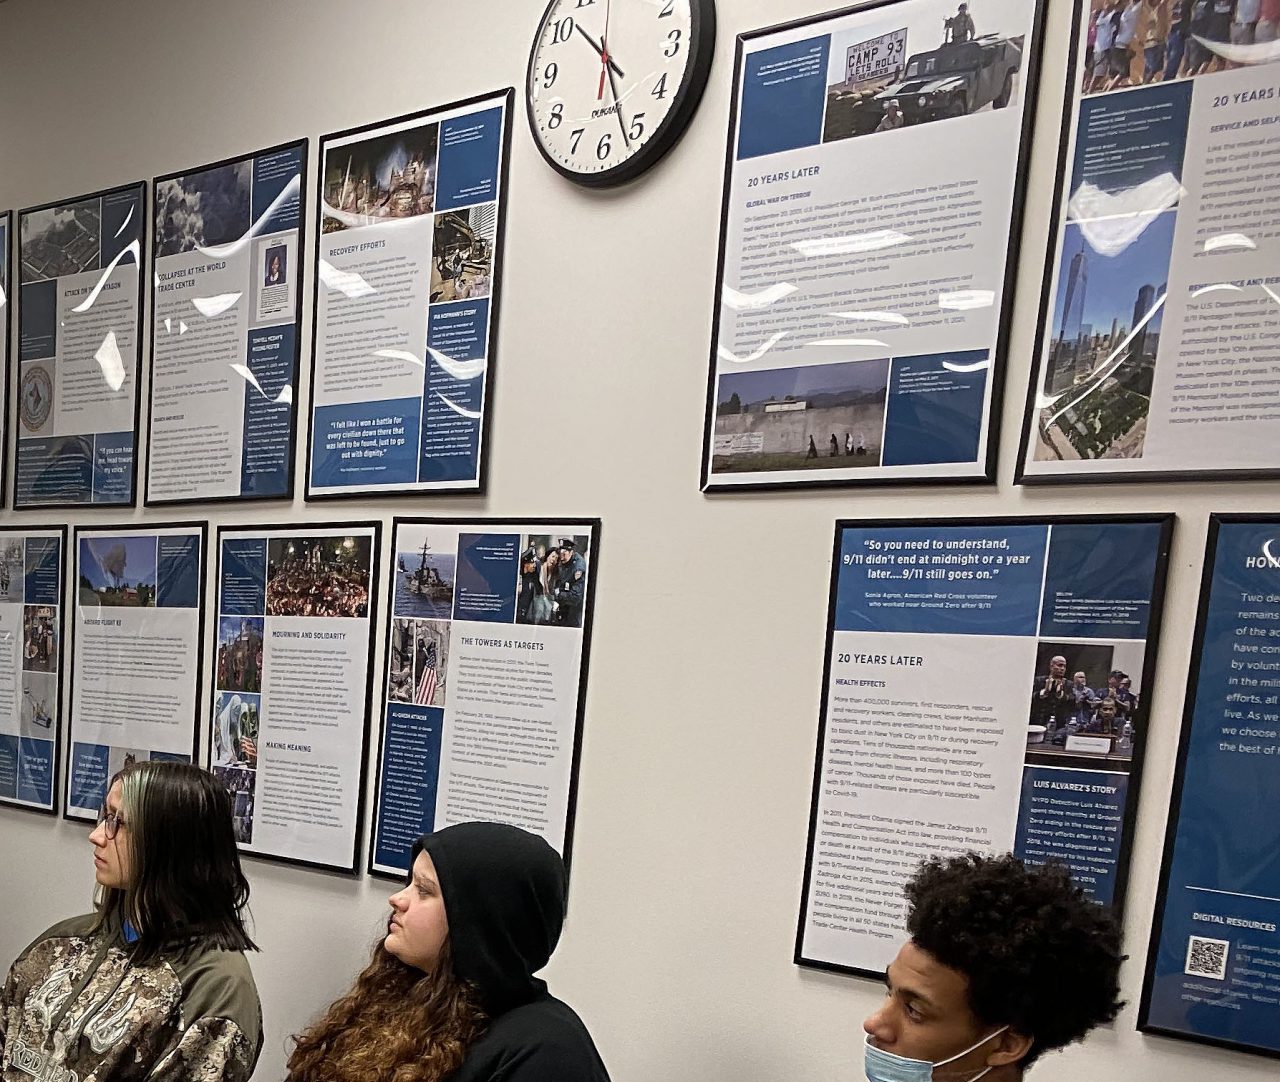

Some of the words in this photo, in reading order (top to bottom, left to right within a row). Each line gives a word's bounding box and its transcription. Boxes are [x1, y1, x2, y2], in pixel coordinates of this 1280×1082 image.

[658, 0, 674, 18] 2
[550, 16, 574, 45] 10
[664, 29, 681, 57] 3
[849, 47, 878, 68] CAMP
[888, 39, 903, 56] 93
[851, 63, 871, 76] LETS
[876, 56, 898, 69] ROLL
[544, 62, 558, 89] 9
[651, 72, 667, 100] 4
[1212, 96, 1228, 108] 20
[1234, 88, 1274, 104] YEARS
[548, 103, 564, 129] 8
[628, 112, 646, 140] 5
[570, 128, 585, 154] 7
[597, 133, 611, 160] 6
[748, 178, 758, 188] 20
[760, 172, 789, 184] YEARS
[792, 166, 820, 179] LATER
[330, 245, 358, 256] RECOVERY
[360, 240, 386, 251] EFFORTS
[206, 262, 226, 271] WORLD
[175, 280, 195, 290] CENTER
[393, 416, 402, 424] for
[397, 438, 405, 446] go
[884, 541, 902, 551] you
[905, 540, 929, 549] need
[932, 540, 943, 549] to
[946, 538, 1010, 550] understand,
[843, 554, 864, 565] 9/11
[866, 554, 895, 564] didn't
[897, 554, 916, 564] end
[918, 555, 930, 564] at
[932, 554, 980, 566] midnight
[982, 556, 994, 564] or
[996, 556, 1004, 564] a
[1006, 556, 1030, 566] year
[926, 569, 946, 578] still
[948, 571, 974, 580] goes
[1242, 593, 1263, 602] Two
[1238, 611, 1280, 620] remains
[314, 632, 346, 640] SOLIDARITY
[1236, 626, 1247, 636] of
[1250, 628, 1266, 636] the
[461, 637, 474, 646] THE
[474, 638, 502, 648] TOWERS
[504, 640, 513, 648] AS
[514, 641, 544, 650] TARGETS
[1234, 643, 1258, 652] have
[838, 654, 850, 663] 20
[854, 654, 888, 664] YEARS
[890, 656, 923, 666] LATER
[1232, 660, 1244, 670] by
[836, 678, 858, 686] HEALTH
[860, 680, 886, 688] EFFECTS
[1229, 676, 1238, 685] in
[1240, 677, 1258, 686] the
[1265, 696, 1278, 704] all
[1247, 711, 1261, 720] As
[1264, 714, 1278, 722] we
[1239, 727, 1276, 739] choose
[266, 742, 286, 750] MAKING
[287, 744, 312, 752] MEANING
[1220, 742, 1236, 752] the
[1238, 744, 1261, 754] best
[1264, 746, 1276, 756] of
[1034, 780, 1050, 788] LUIS
[1050, 782, 1090, 792] ALVAREZ'S
[1092, 786, 1118, 794] STORY
[1192, 912, 1224, 924] DIGITAL
[1226, 917, 1276, 932] RESOURCES
